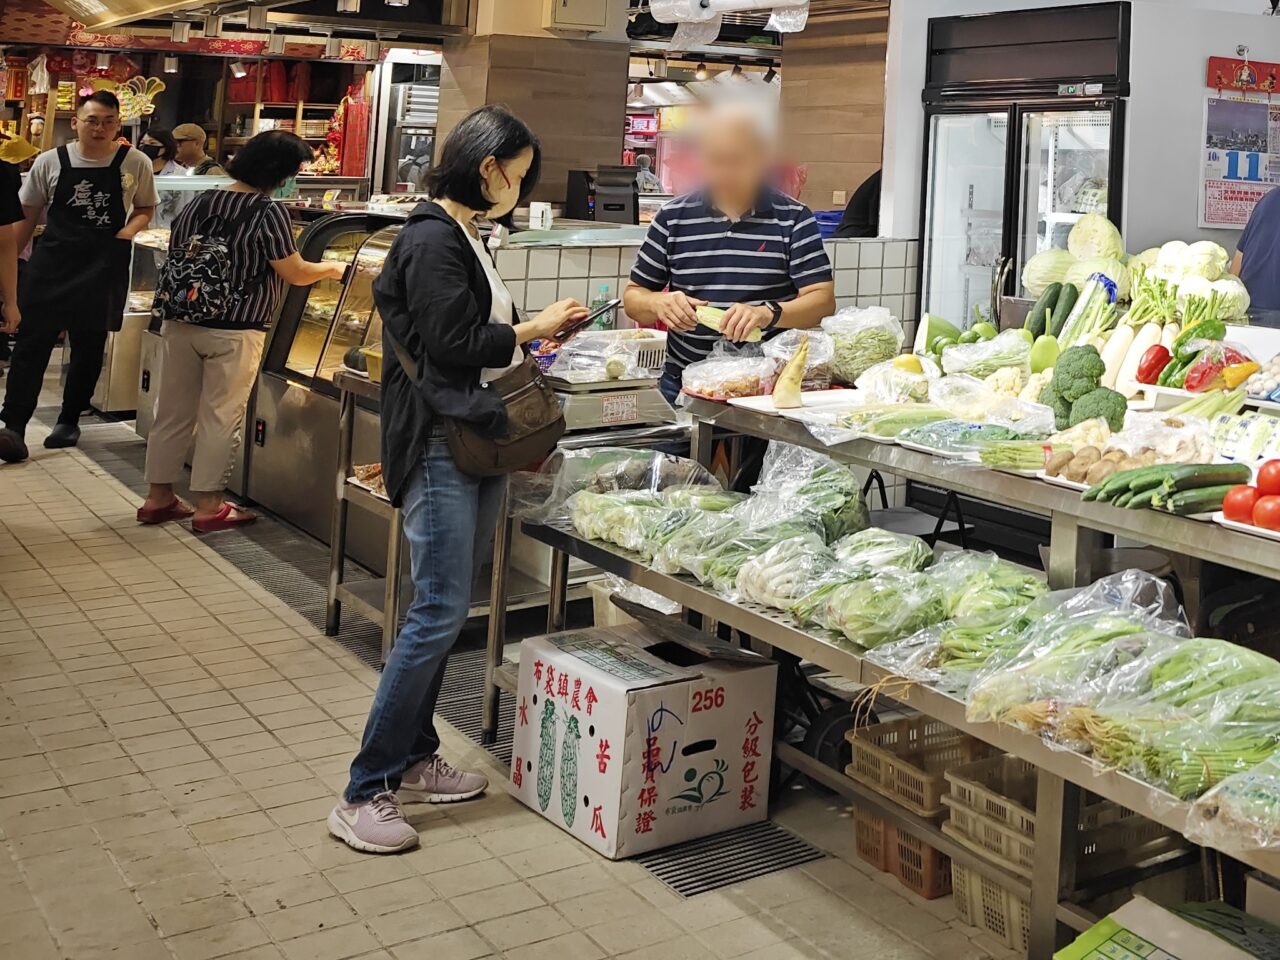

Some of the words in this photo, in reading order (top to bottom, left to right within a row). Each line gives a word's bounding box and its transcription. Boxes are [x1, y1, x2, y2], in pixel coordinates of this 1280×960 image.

[1222, 150, 1263, 182] 11
[533, 659, 598, 717] 布袋鎮農會
[691, 686, 725, 713] 256
[739, 711, 764, 811] 分級包裝
